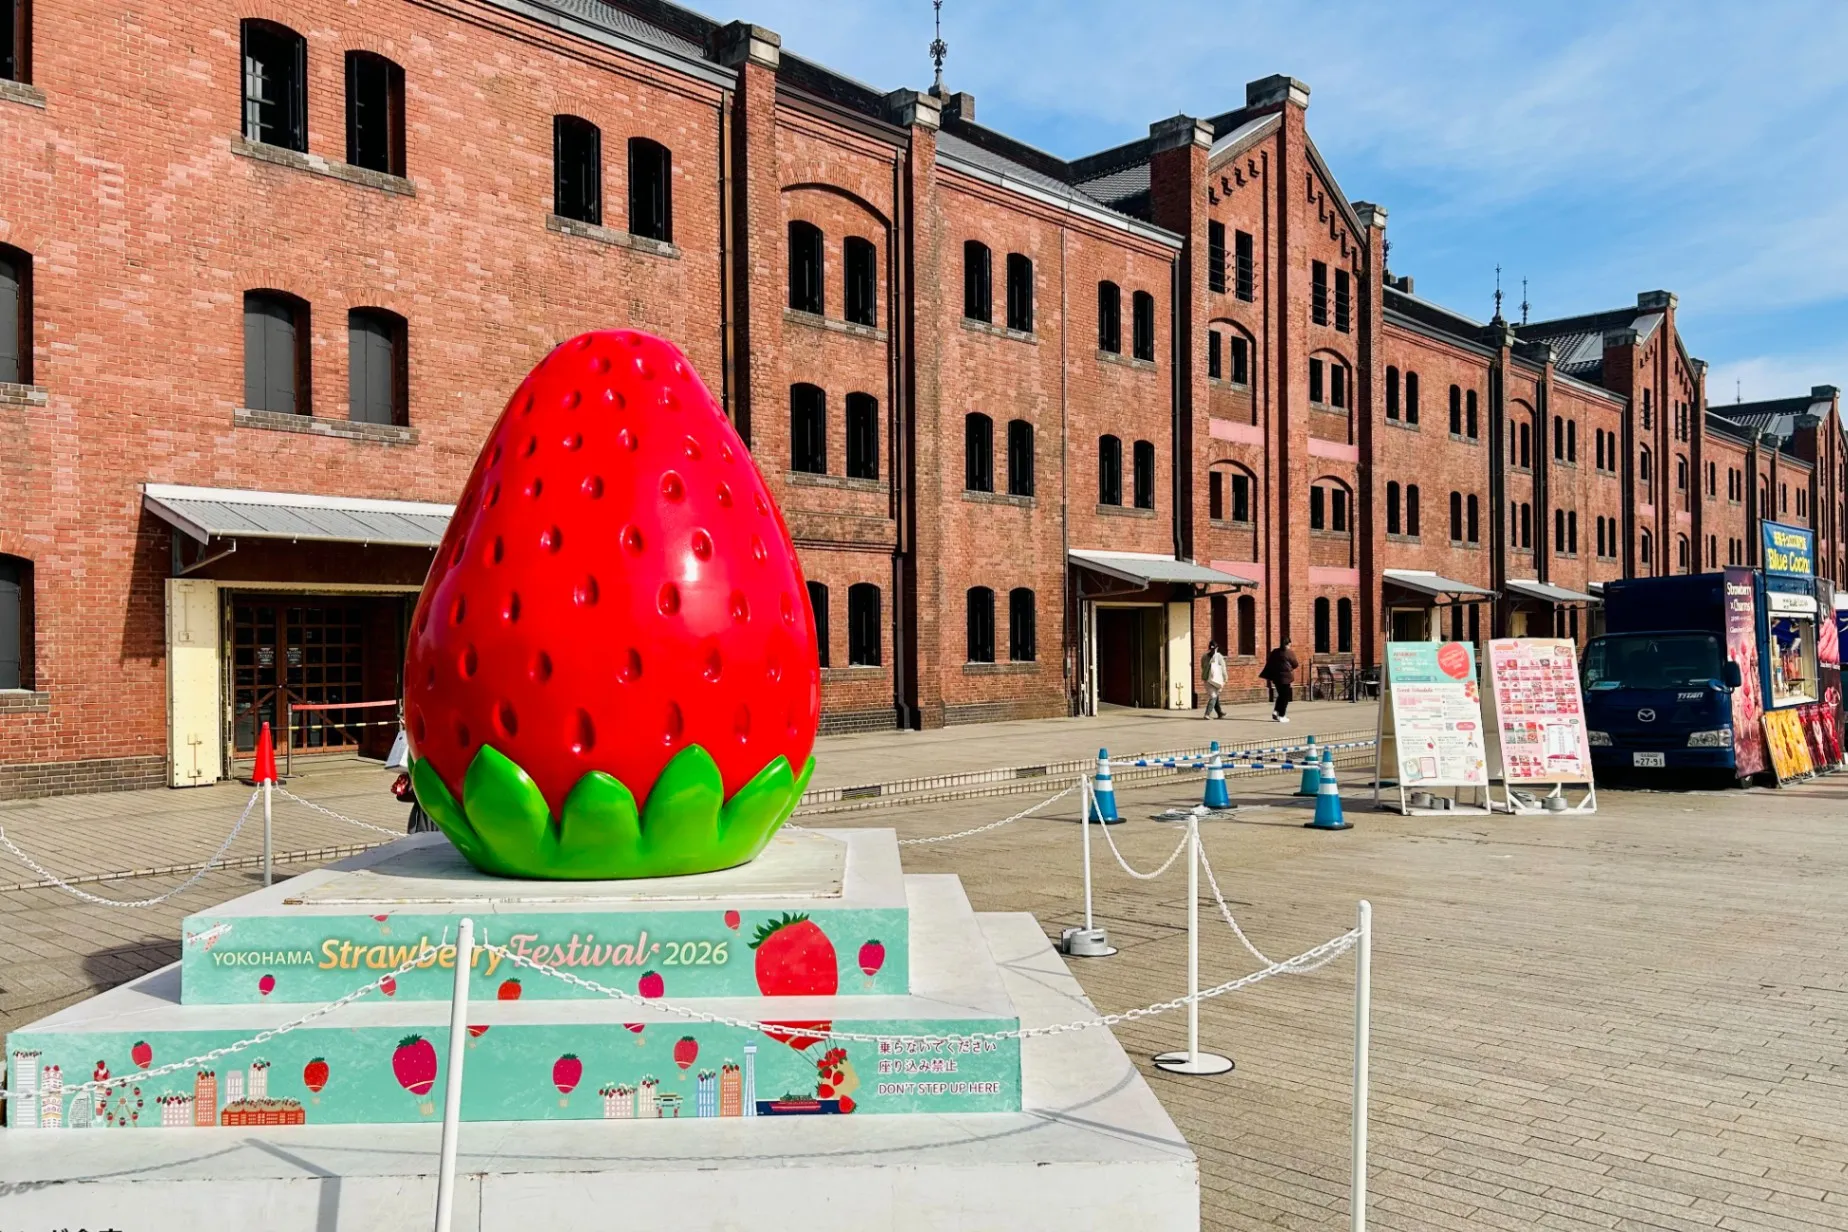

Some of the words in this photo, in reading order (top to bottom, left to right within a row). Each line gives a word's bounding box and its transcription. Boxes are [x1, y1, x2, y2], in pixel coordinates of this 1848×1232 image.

[1767, 548, 1788, 571] Blue
[1677, 691, 1704, 699] TITAN
[213, 950, 315, 967] YOKOHAMA
[318, 935, 508, 976] Strawbery
[510, 931, 651, 967] Festival
[662, 941, 729, 966] 2026
[879, 1039, 998, 1054] 乗らないでください
[878, 1059, 958, 1074] 座り込み禁止
[879, 1083, 915, 1095] DON'T
[918, 1083, 948, 1094] STEP
[950, 1082, 967, 1094] UP
[968, 1082, 1000, 1093] HERE
